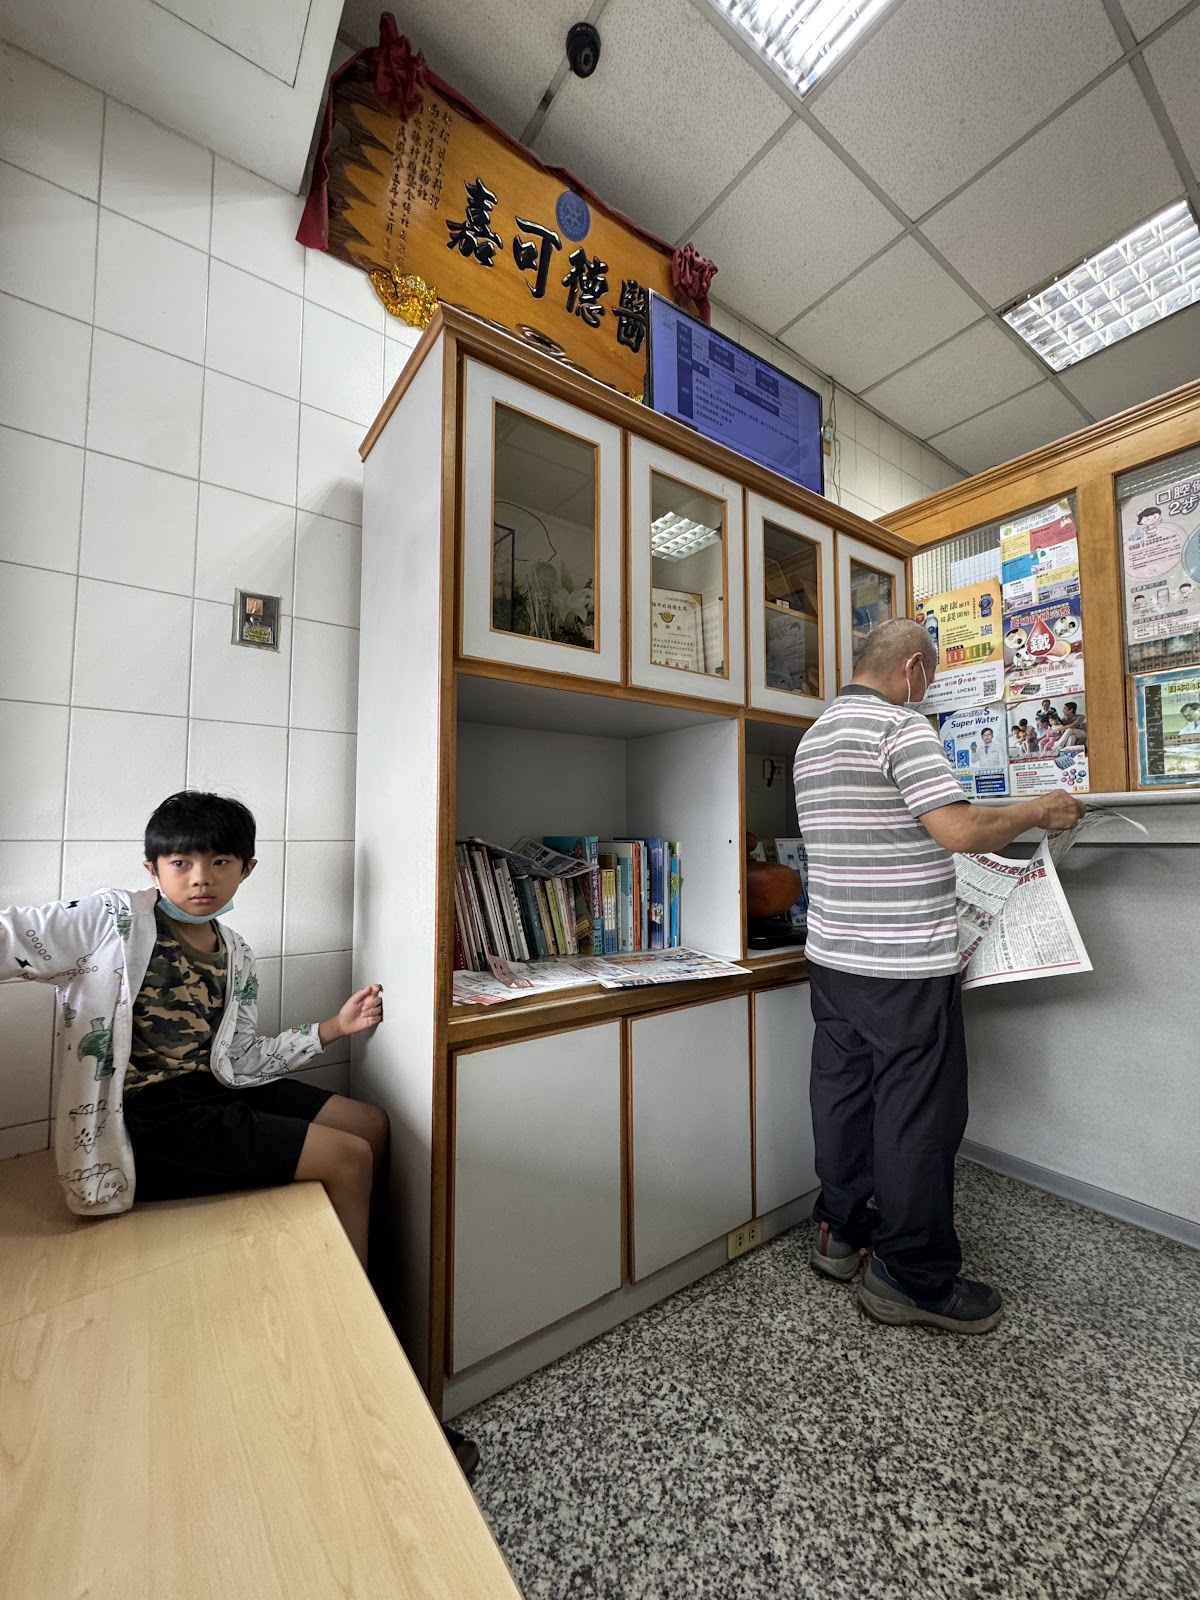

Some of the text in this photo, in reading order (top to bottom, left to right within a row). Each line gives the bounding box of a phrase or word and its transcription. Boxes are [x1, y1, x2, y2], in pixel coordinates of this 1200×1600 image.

[1030, 633, 1051, 653] 鐵
[951, 715, 999, 729] Super Water
